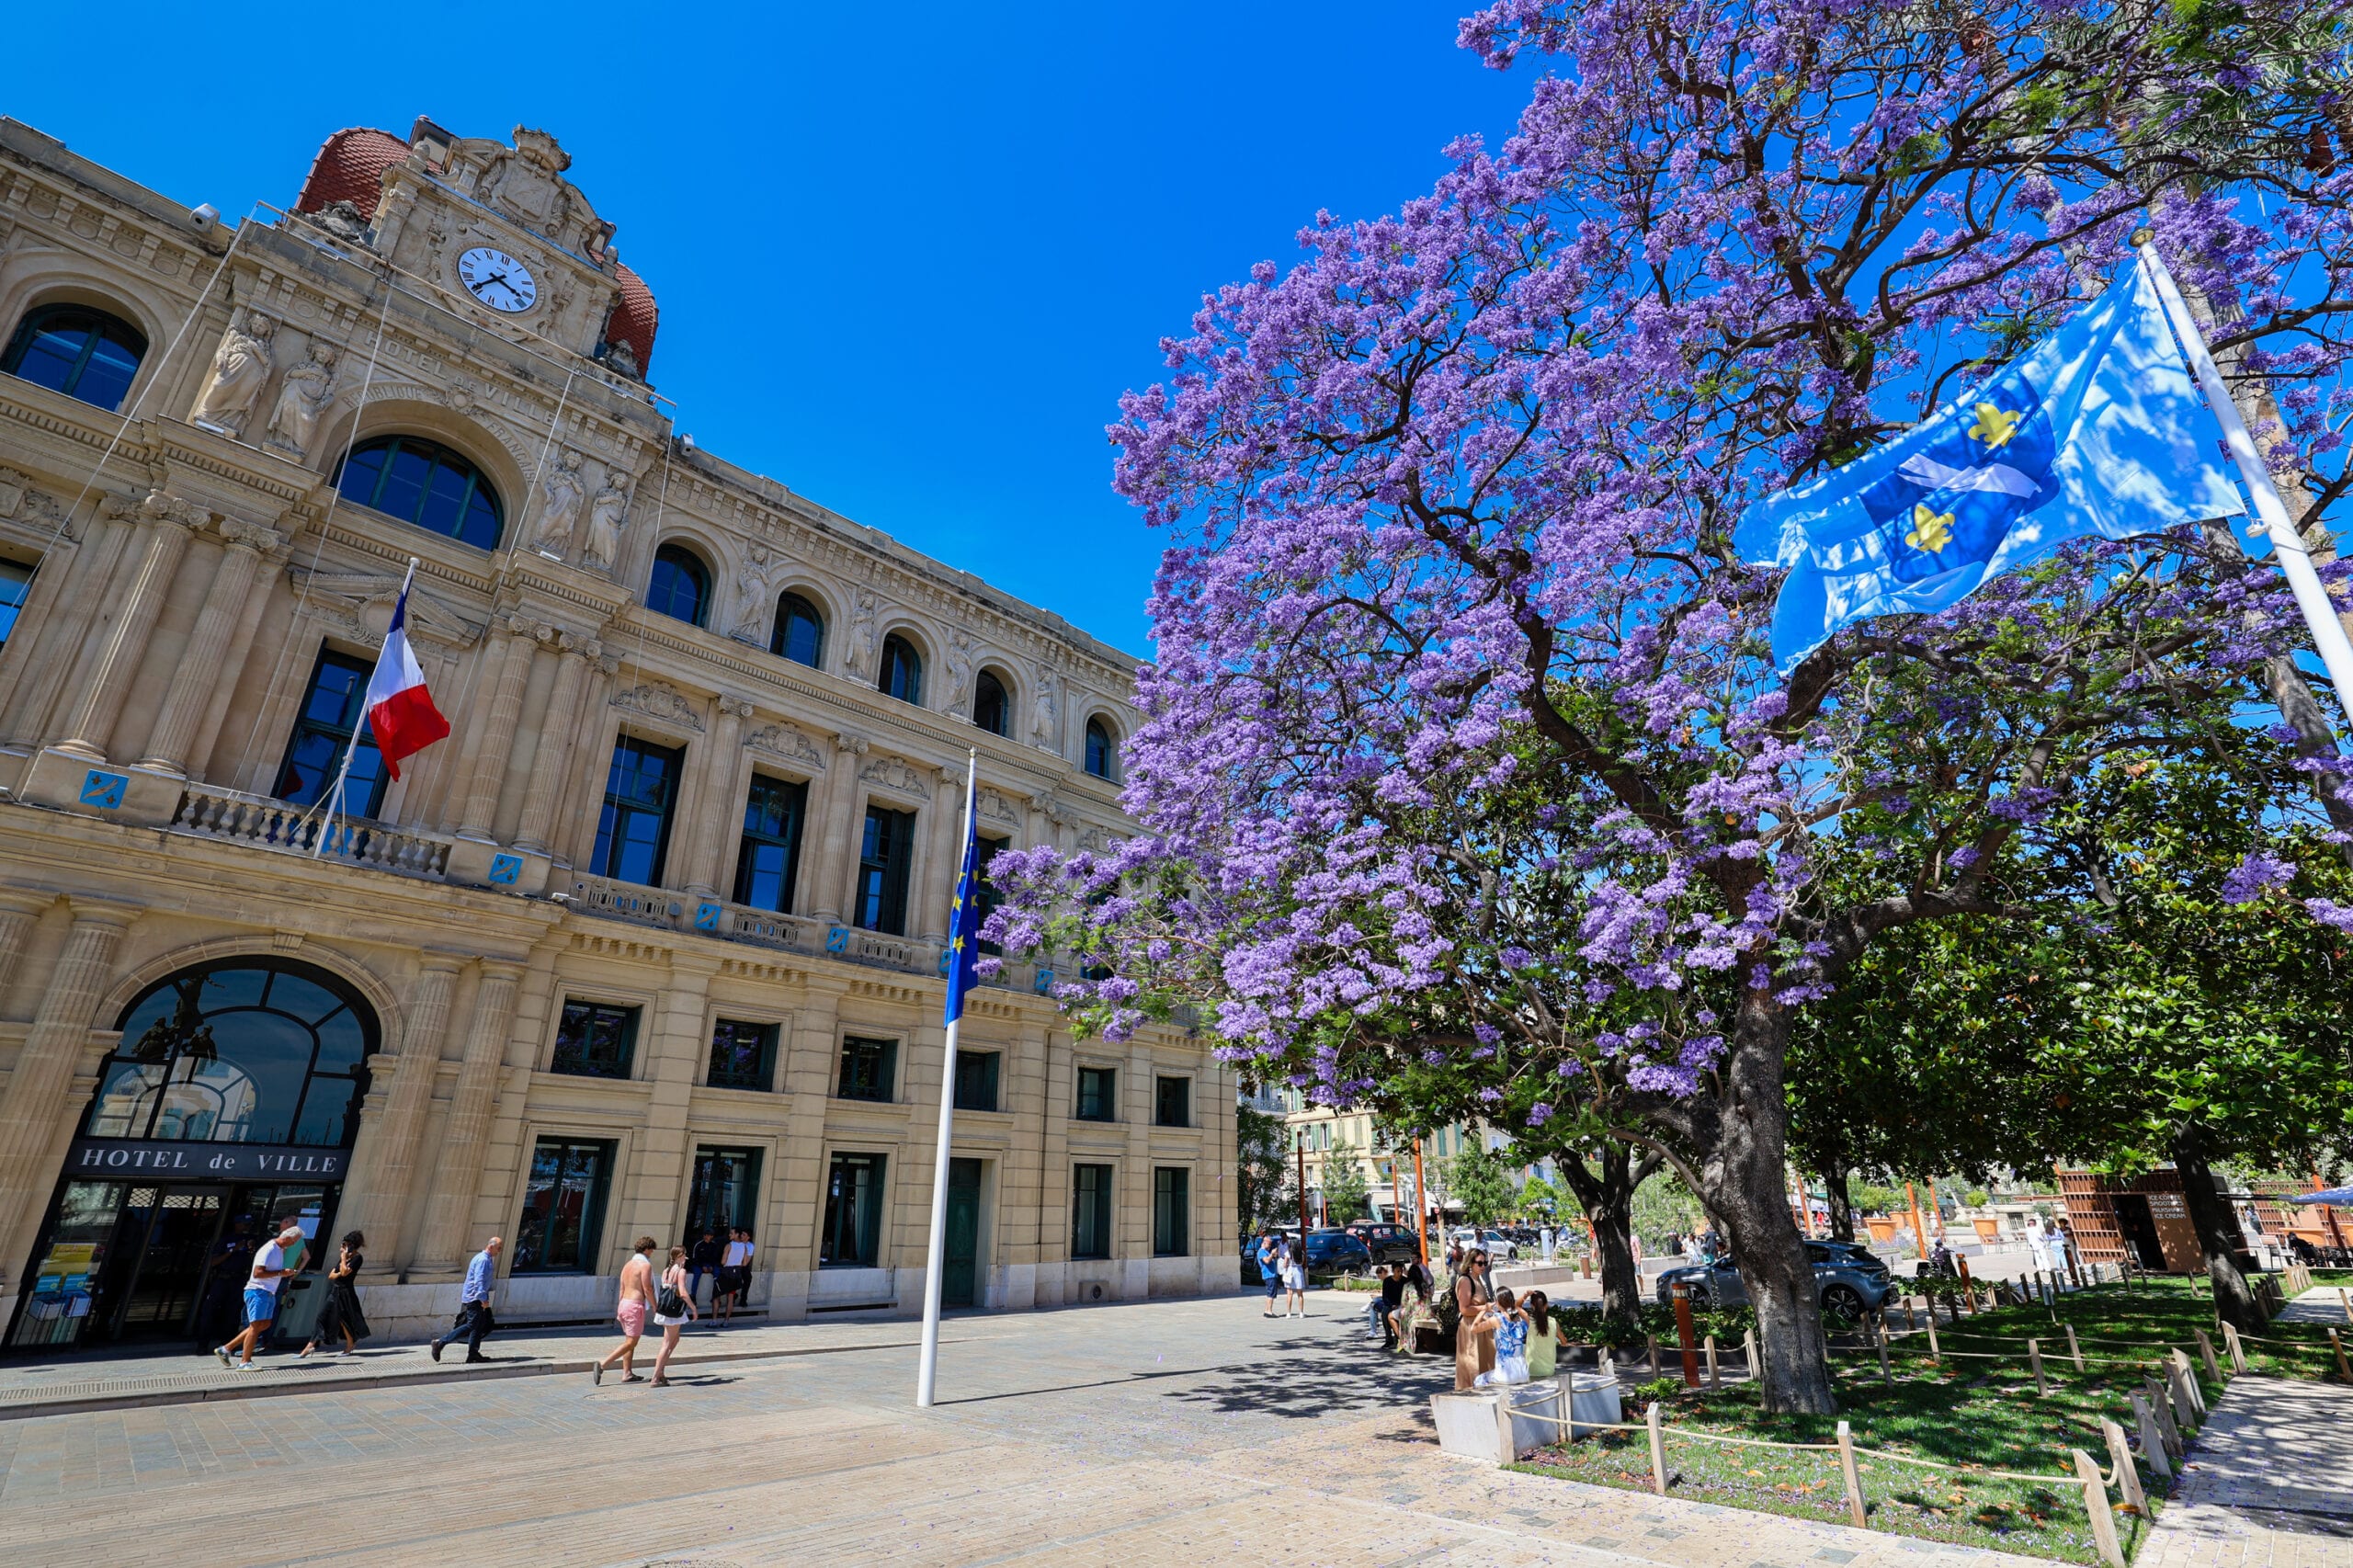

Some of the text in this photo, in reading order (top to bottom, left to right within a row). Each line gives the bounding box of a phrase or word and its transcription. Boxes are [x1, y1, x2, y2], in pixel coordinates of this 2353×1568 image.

[454, 375, 477, 393] DE
[485, 382, 558, 428] VILLE
[81, 1149, 337, 1173] HOTEL de VILLE
